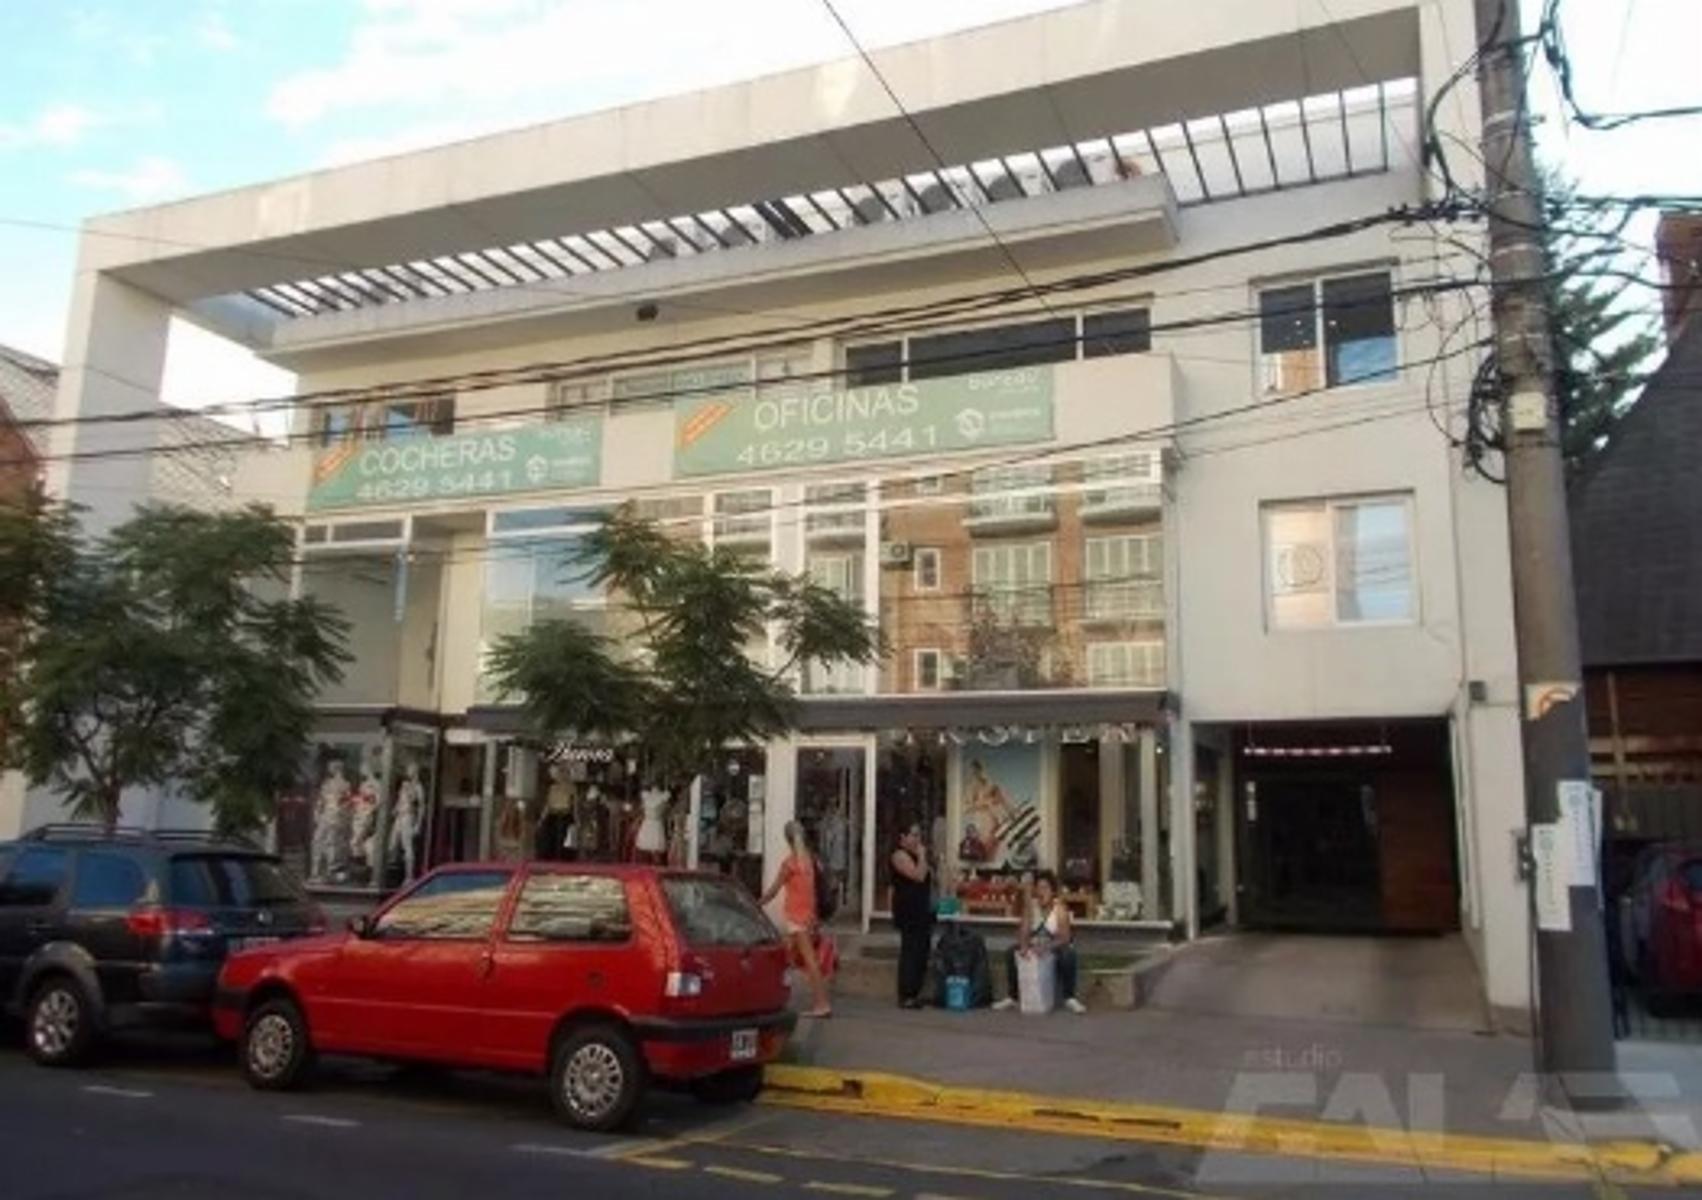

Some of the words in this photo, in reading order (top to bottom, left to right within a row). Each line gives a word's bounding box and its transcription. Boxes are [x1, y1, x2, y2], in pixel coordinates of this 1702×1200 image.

[754, 385, 920, 431] OFICINAS
[358, 435, 517, 476] COCHERAS
[736, 438, 829, 466] 4629
[843, 425, 938, 458] 5441
[356, 479, 430, 500] 4629
[439, 470, 513, 495] 5441
